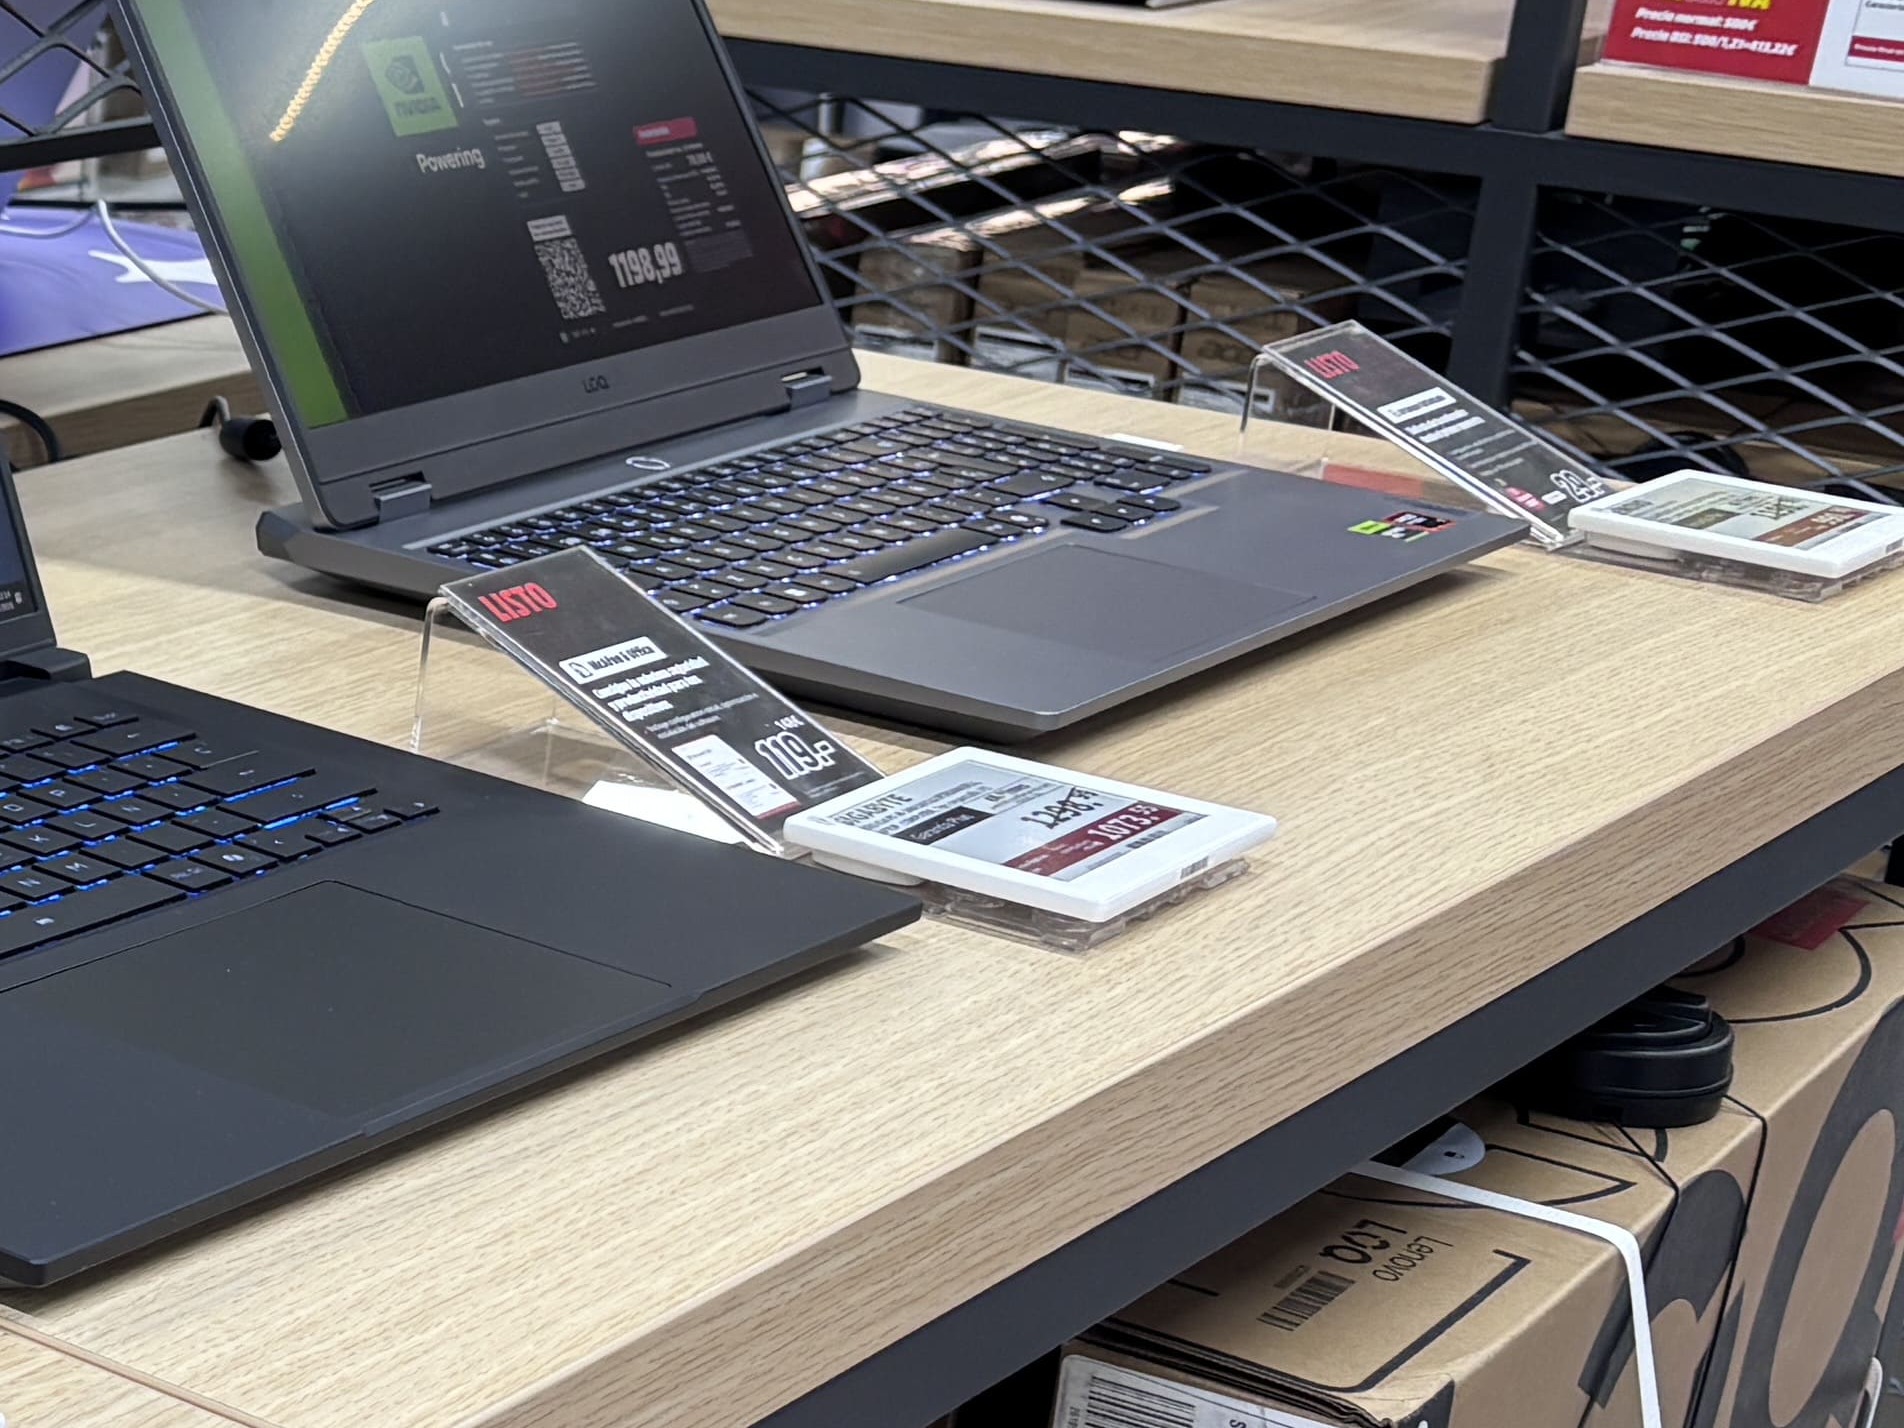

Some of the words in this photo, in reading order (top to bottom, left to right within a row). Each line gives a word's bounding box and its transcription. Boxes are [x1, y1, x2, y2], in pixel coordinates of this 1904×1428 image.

[415, 148, 486, 175] Powering
[608, 241, 685, 289] 1198,99
[478, 581, 559, 623] LISTO
[1371, 1234, 1454, 1283] Lenovo
